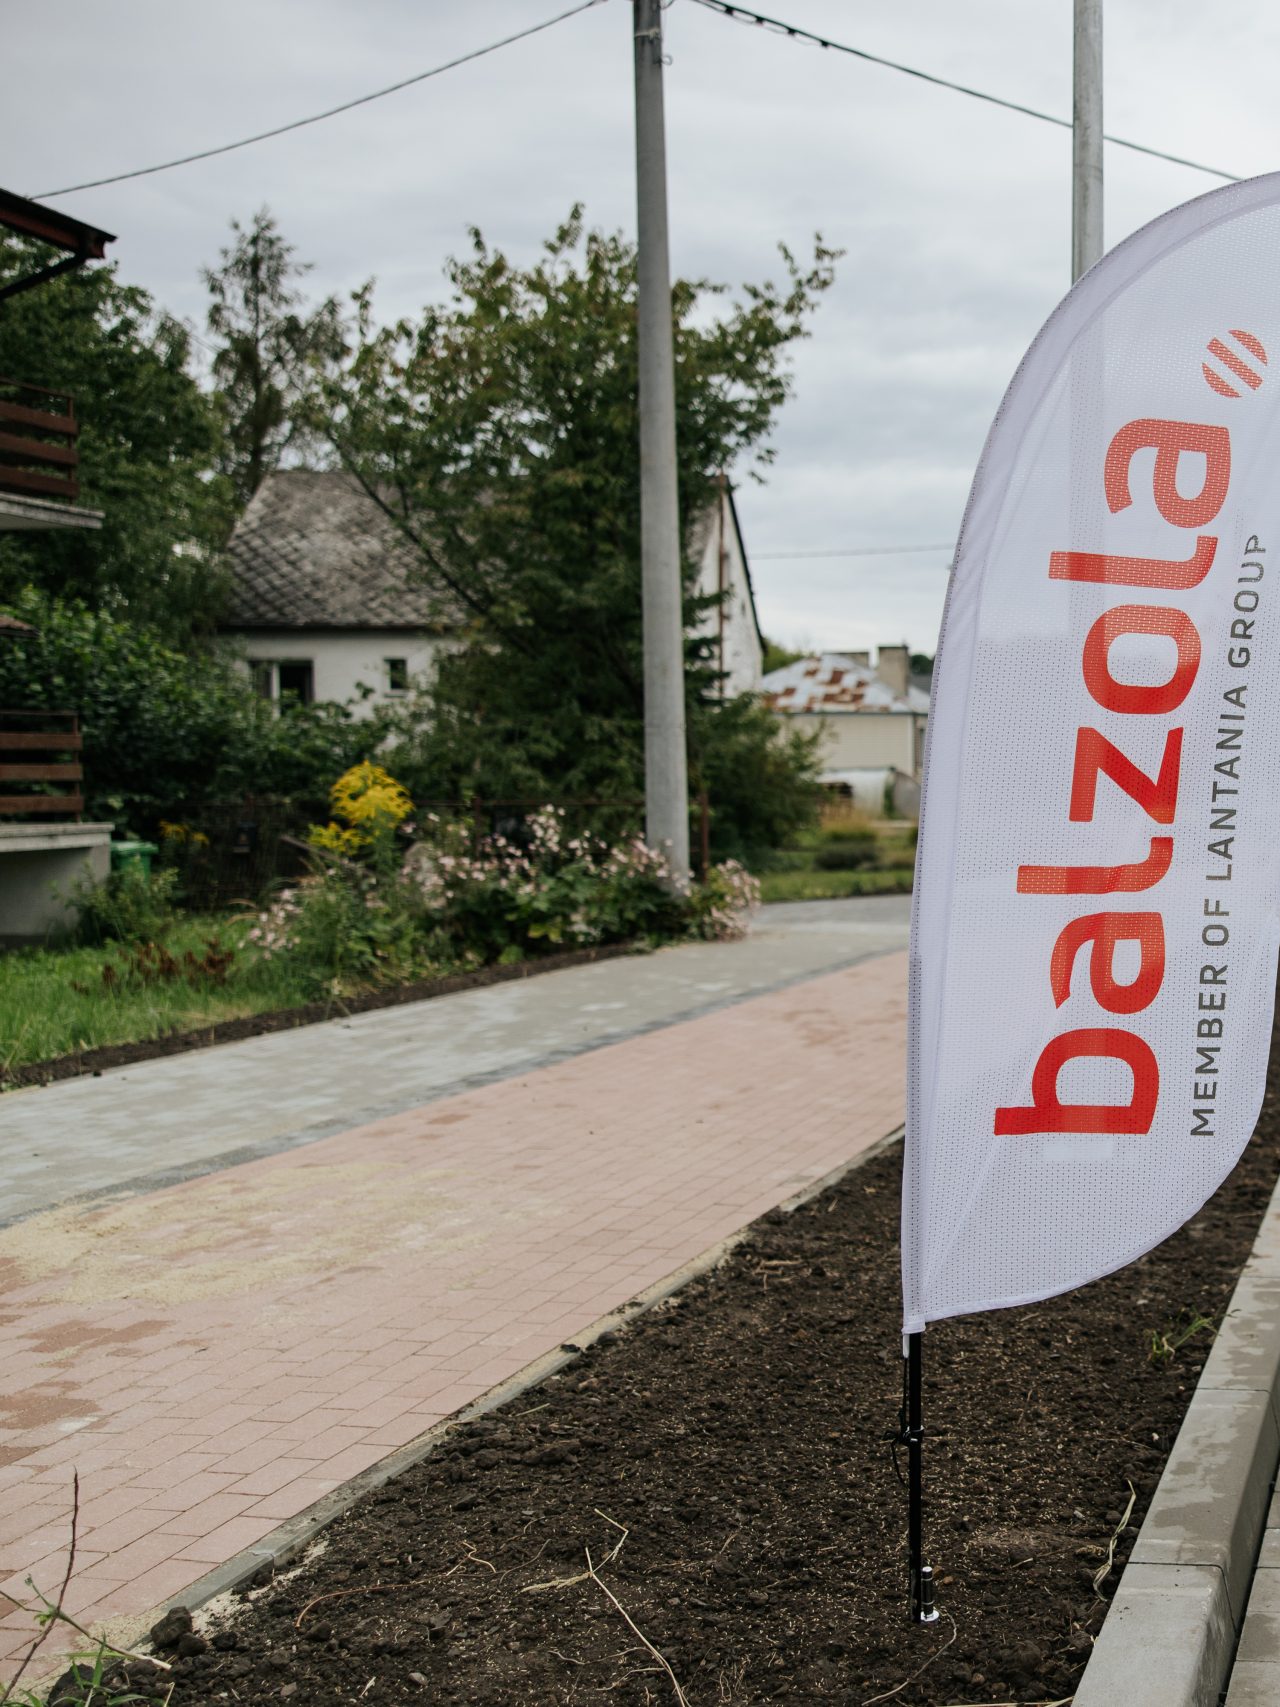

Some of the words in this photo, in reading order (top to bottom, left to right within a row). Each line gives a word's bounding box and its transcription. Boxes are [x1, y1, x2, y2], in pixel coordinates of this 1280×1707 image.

[1229, 534, 1267, 669] GROUP
[994, 418, 1231, 1136] balzola
[1205, 685, 1248, 882] LANTANIA
[1202, 898, 1230, 947] OF
[1190, 964, 1229, 1137] MEMBER
